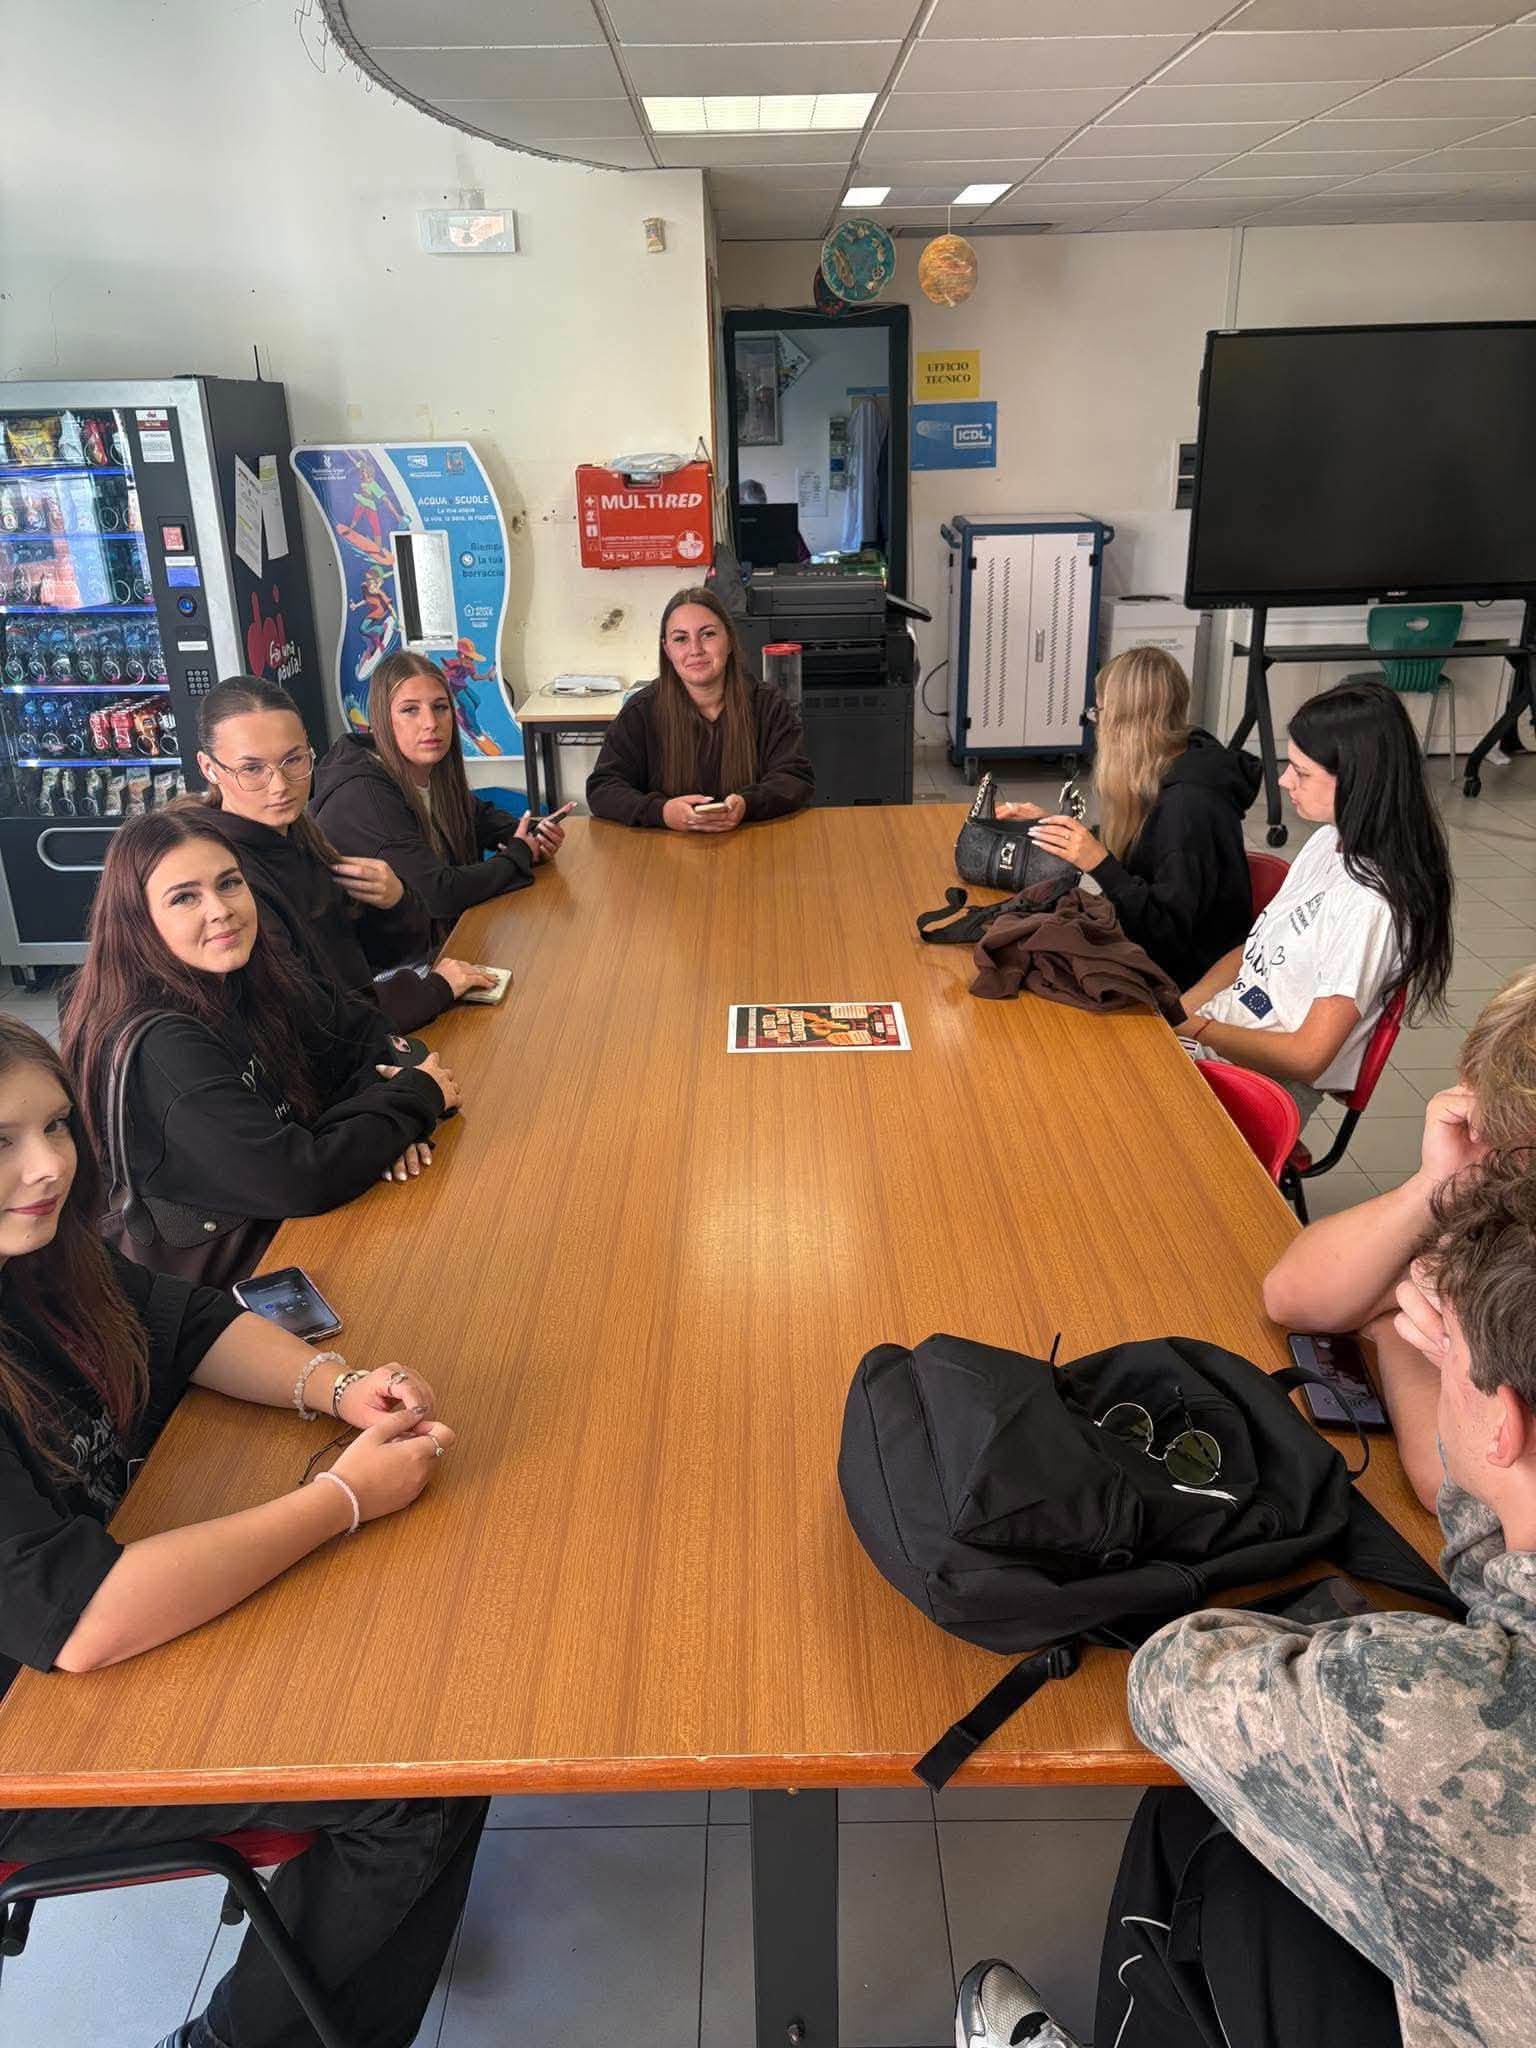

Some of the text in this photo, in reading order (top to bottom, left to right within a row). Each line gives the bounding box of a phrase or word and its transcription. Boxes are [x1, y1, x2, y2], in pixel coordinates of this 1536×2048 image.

[927, 361, 969, 373] UFFICIO
[924, 373, 971, 385] TECNICO
[958, 429, 988, 441] ICDL
[418, 495, 489, 505] ACQUA SCUOLE
[601, 493, 703, 510] MULTIRED
